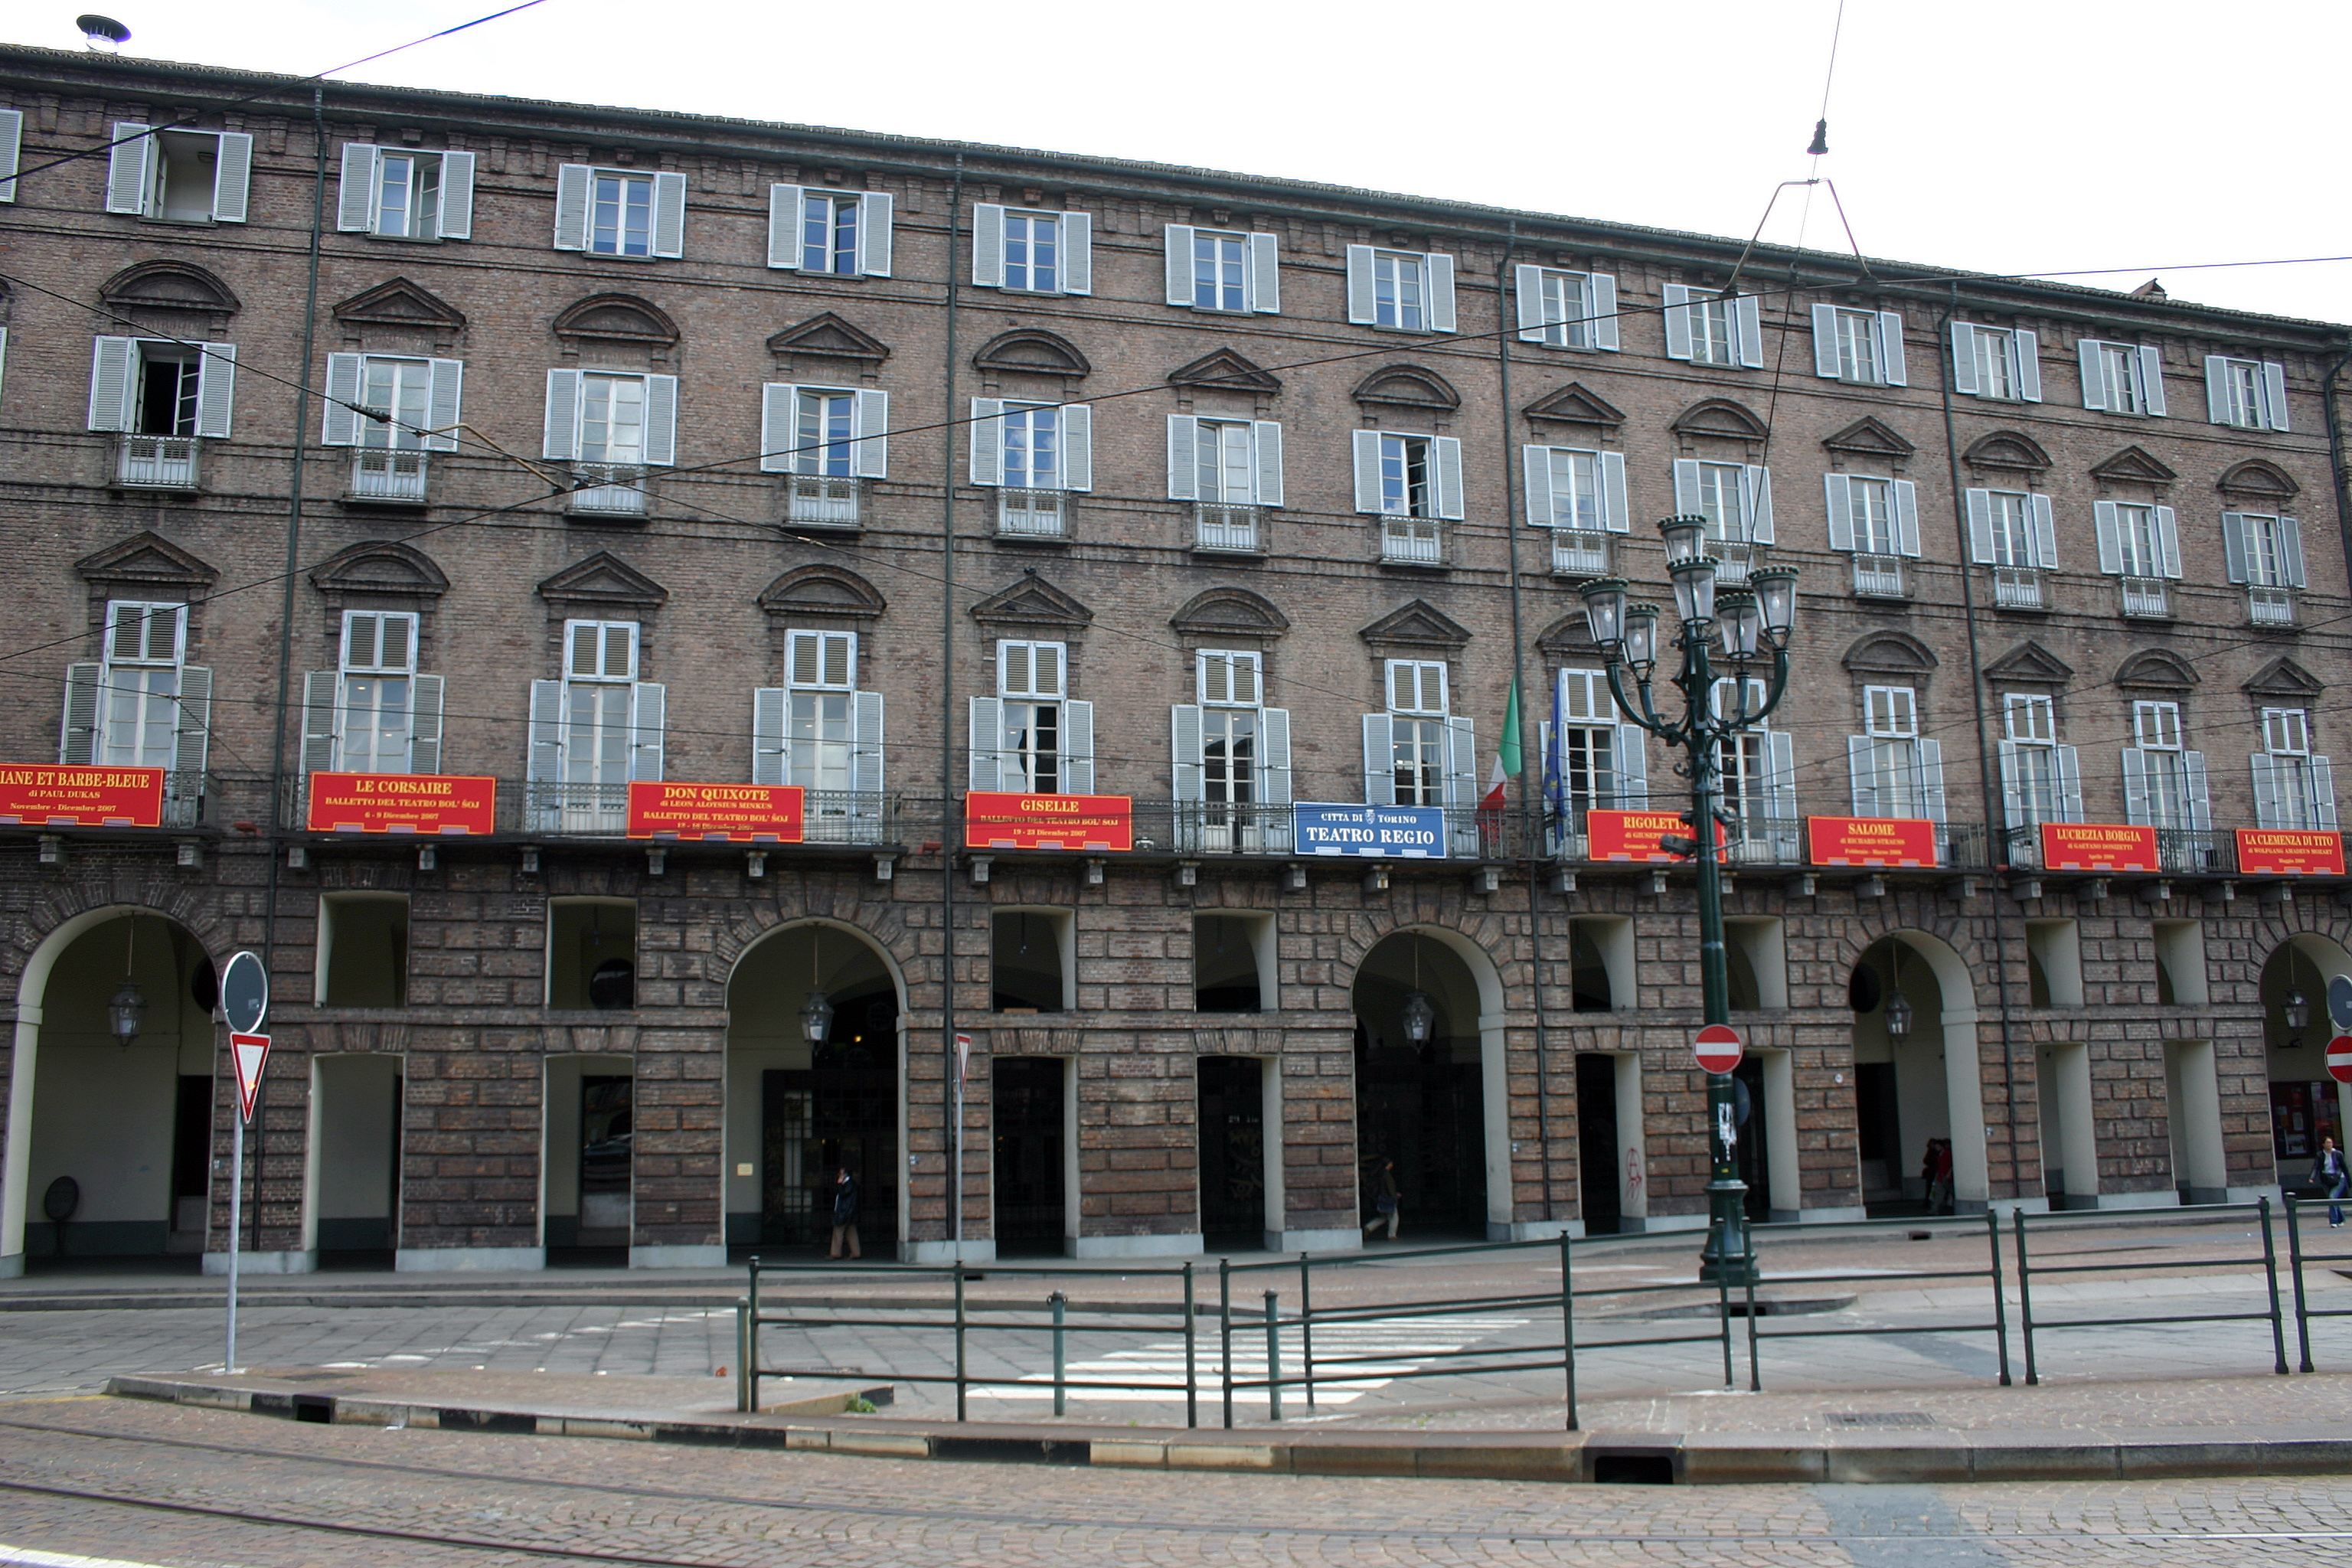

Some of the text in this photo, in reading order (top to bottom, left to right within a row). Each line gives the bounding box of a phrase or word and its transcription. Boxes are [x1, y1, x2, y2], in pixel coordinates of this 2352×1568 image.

[37, 772, 55, 786] ET
[58, 772, 149, 788] BARBE-BLEUE
[355, 780, 452, 795] LE CORSAIRE
[665, 787, 769, 802] DON QUIXOTE
[1021, 799, 1079, 812] GISELLE
[711, 813, 748, 822] TEATRO
[1352, 814, 1363, 822] DI
[1378, 815, 1416, 824] TORINO
[1306, 827, 1434, 844] TEATRO REGIO
[1848, 823, 1895, 836] SALOME
[2056, 828, 2141, 842] LUCREZIA BORGIA
[2245, 834, 2333, 846] LA CLEMENZA DI TITO
